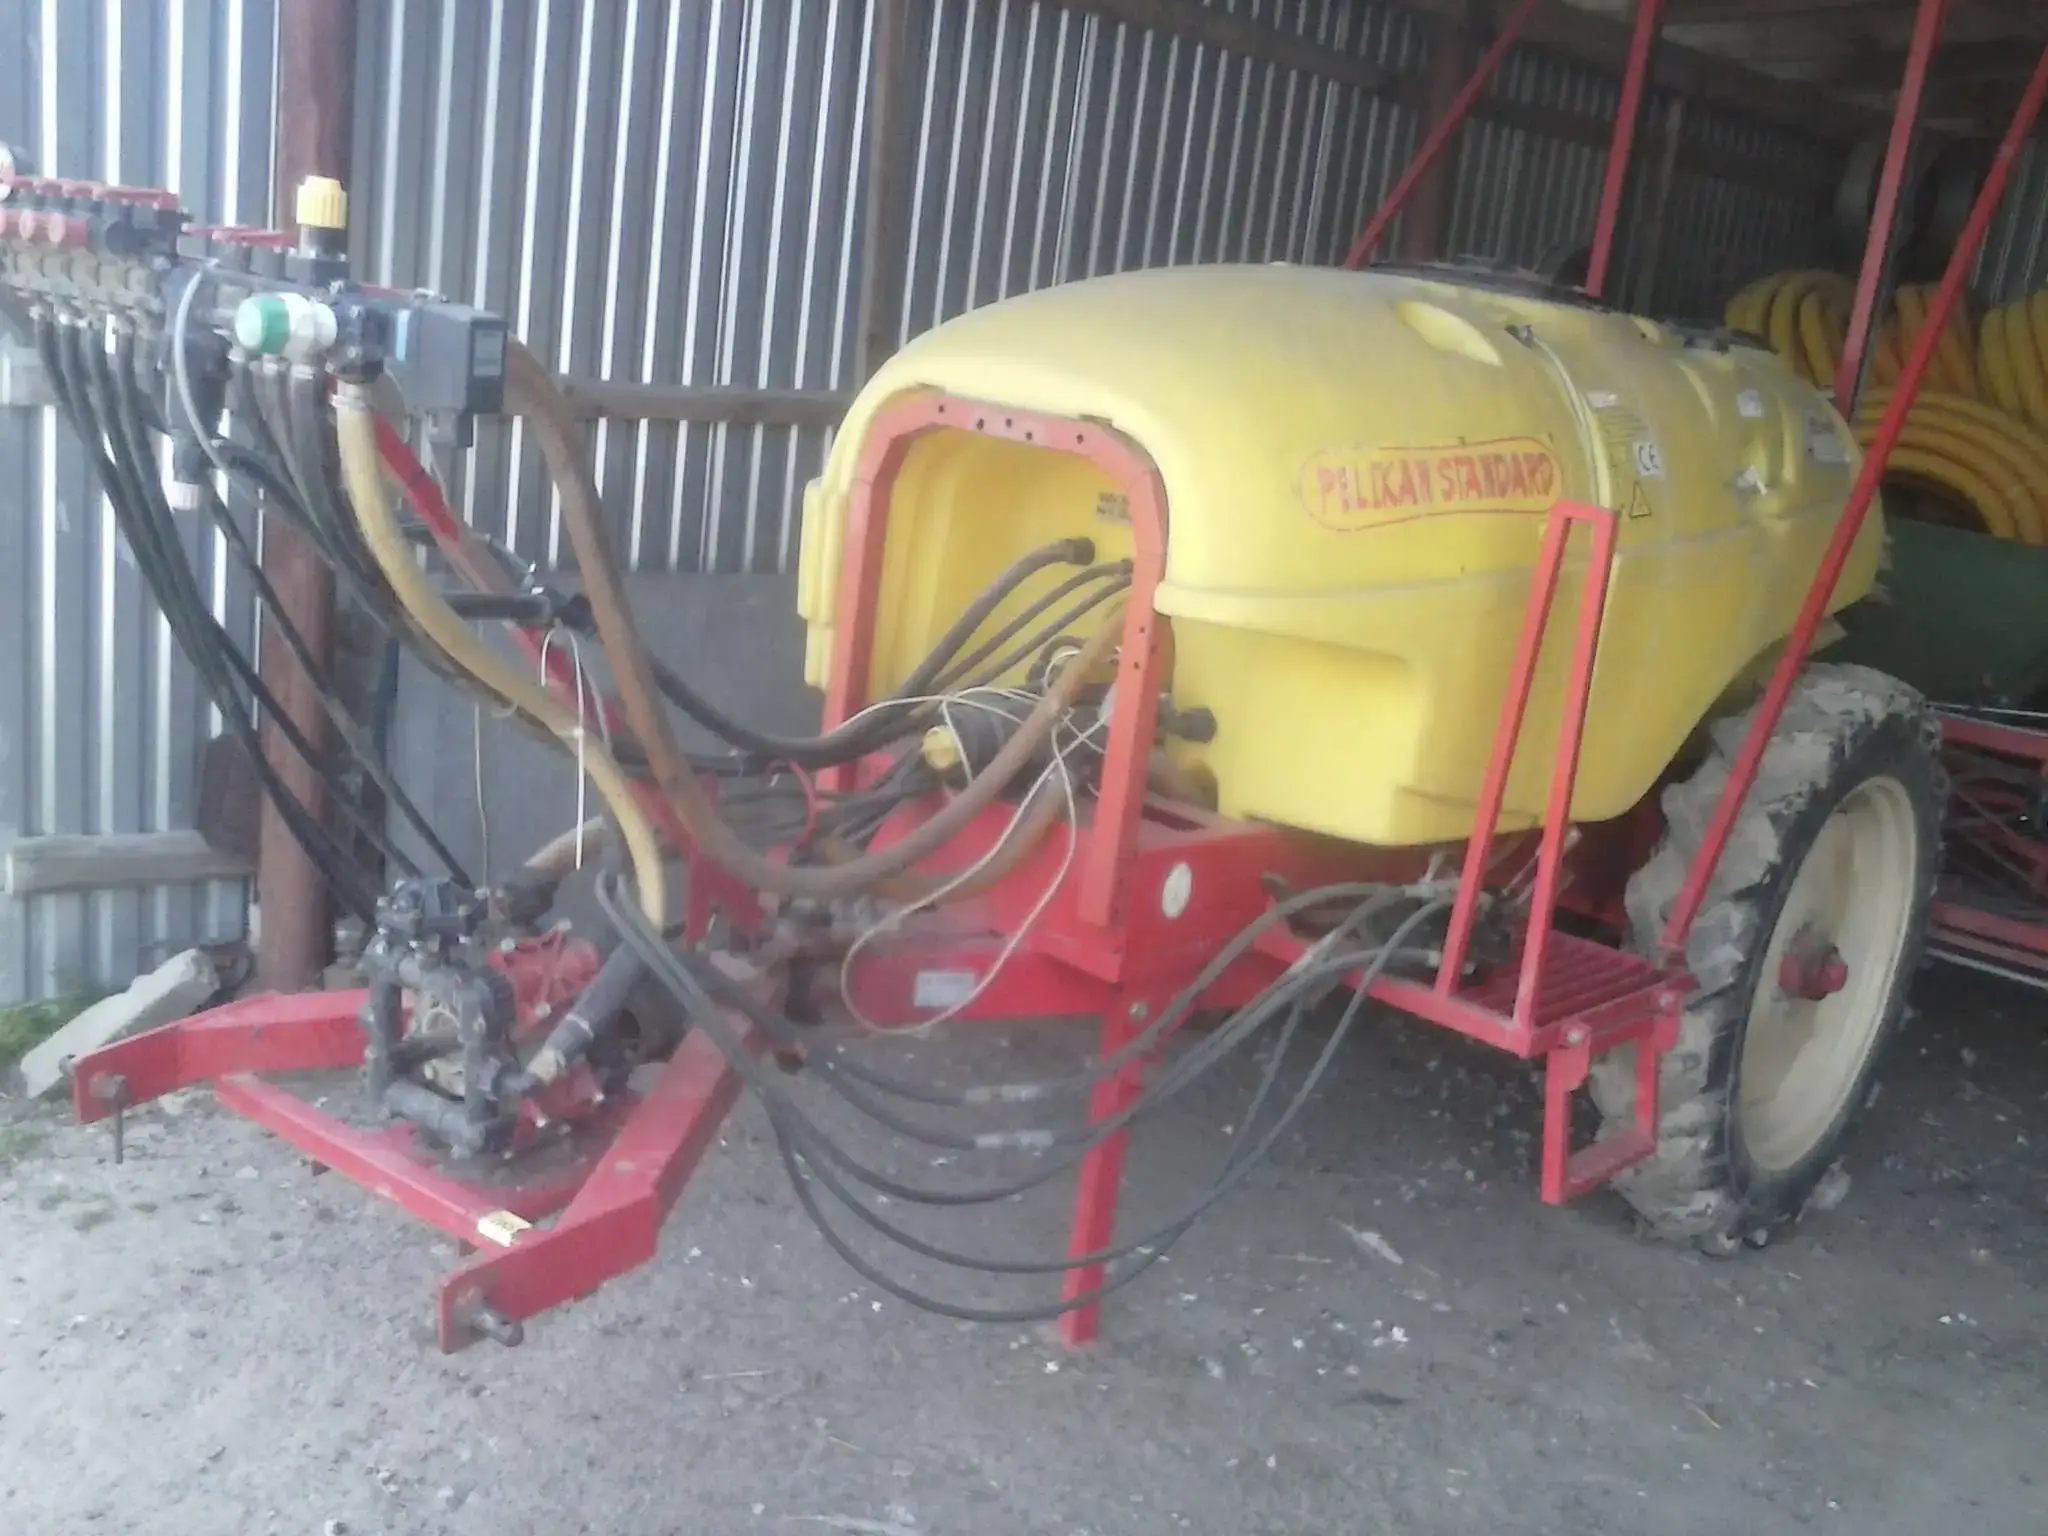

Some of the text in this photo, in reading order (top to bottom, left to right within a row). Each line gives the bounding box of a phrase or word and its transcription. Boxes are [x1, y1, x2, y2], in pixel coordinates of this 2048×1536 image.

[1637, 442, 1660, 472] CE
[1317, 451, 1554, 515] PELIKAN STANDARD
